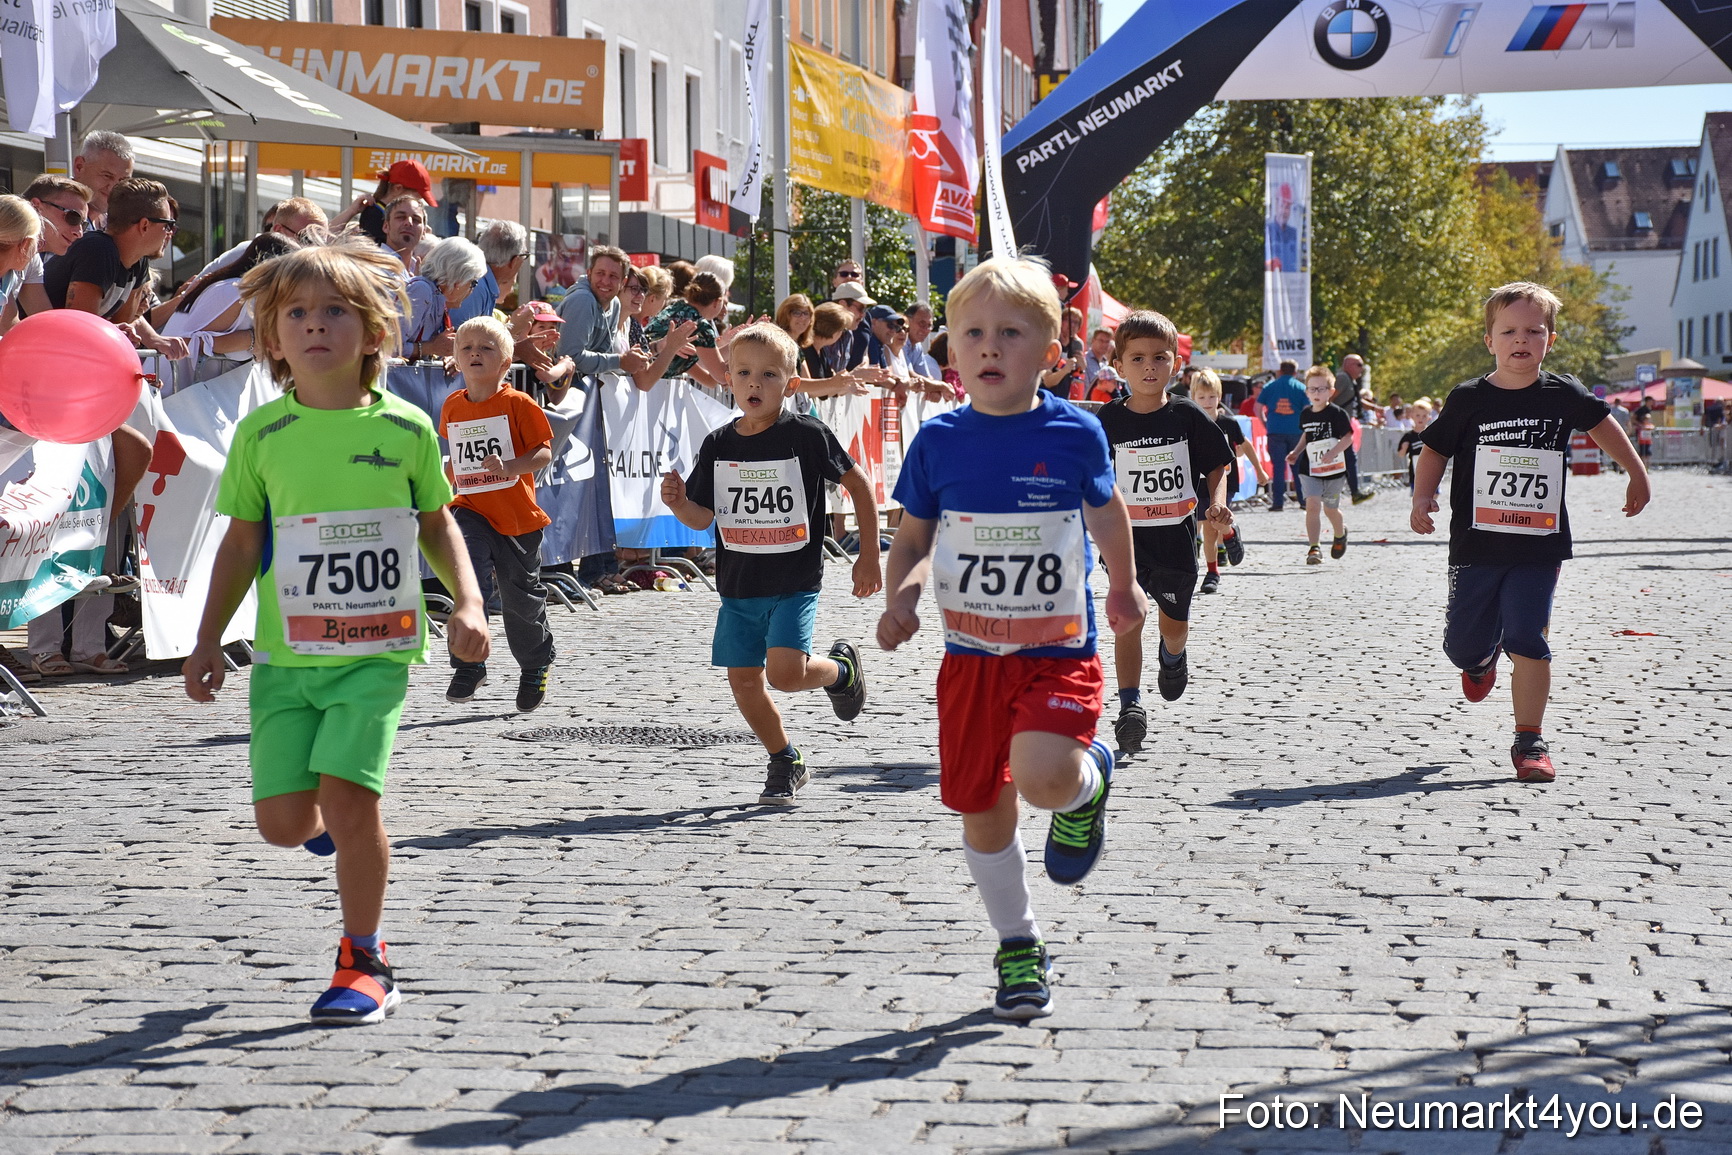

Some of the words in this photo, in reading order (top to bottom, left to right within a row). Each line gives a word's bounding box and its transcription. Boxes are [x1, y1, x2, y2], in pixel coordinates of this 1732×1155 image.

[1015, 129, 1080, 174] PARTL
[1077, 59, 1184, 136] NEUMARKT
[1478, 418, 1539, 433] Neumarkter
[1479, 430, 1528, 445] Stadtlauf
[456, 437, 502, 463] 7456
[1138, 452, 1174, 463] BOCK
[1500, 455, 1539, 466] BOCK
[739, 469, 778, 479] BOCK
[1128, 465, 1184, 493] 7566
[1487, 471, 1549, 500] 7375
[727, 486, 794, 514] 7546
[1509, 500, 1536, 508] Neumarkt
[1499, 512, 1531, 524] Julian
[319, 522, 381, 540] BOCK
[974, 526, 1041, 541] BOCK
[299, 548, 400, 595] 7508
[957, 553, 1062, 596] 7578
[313, 602, 343, 610] PARTL
[346, 600, 386, 610] Neumarkt
[964, 601, 994, 611] PARTL
[996, 602, 1041, 611] Neumarkt
[322, 619, 390, 645] Bjarne
